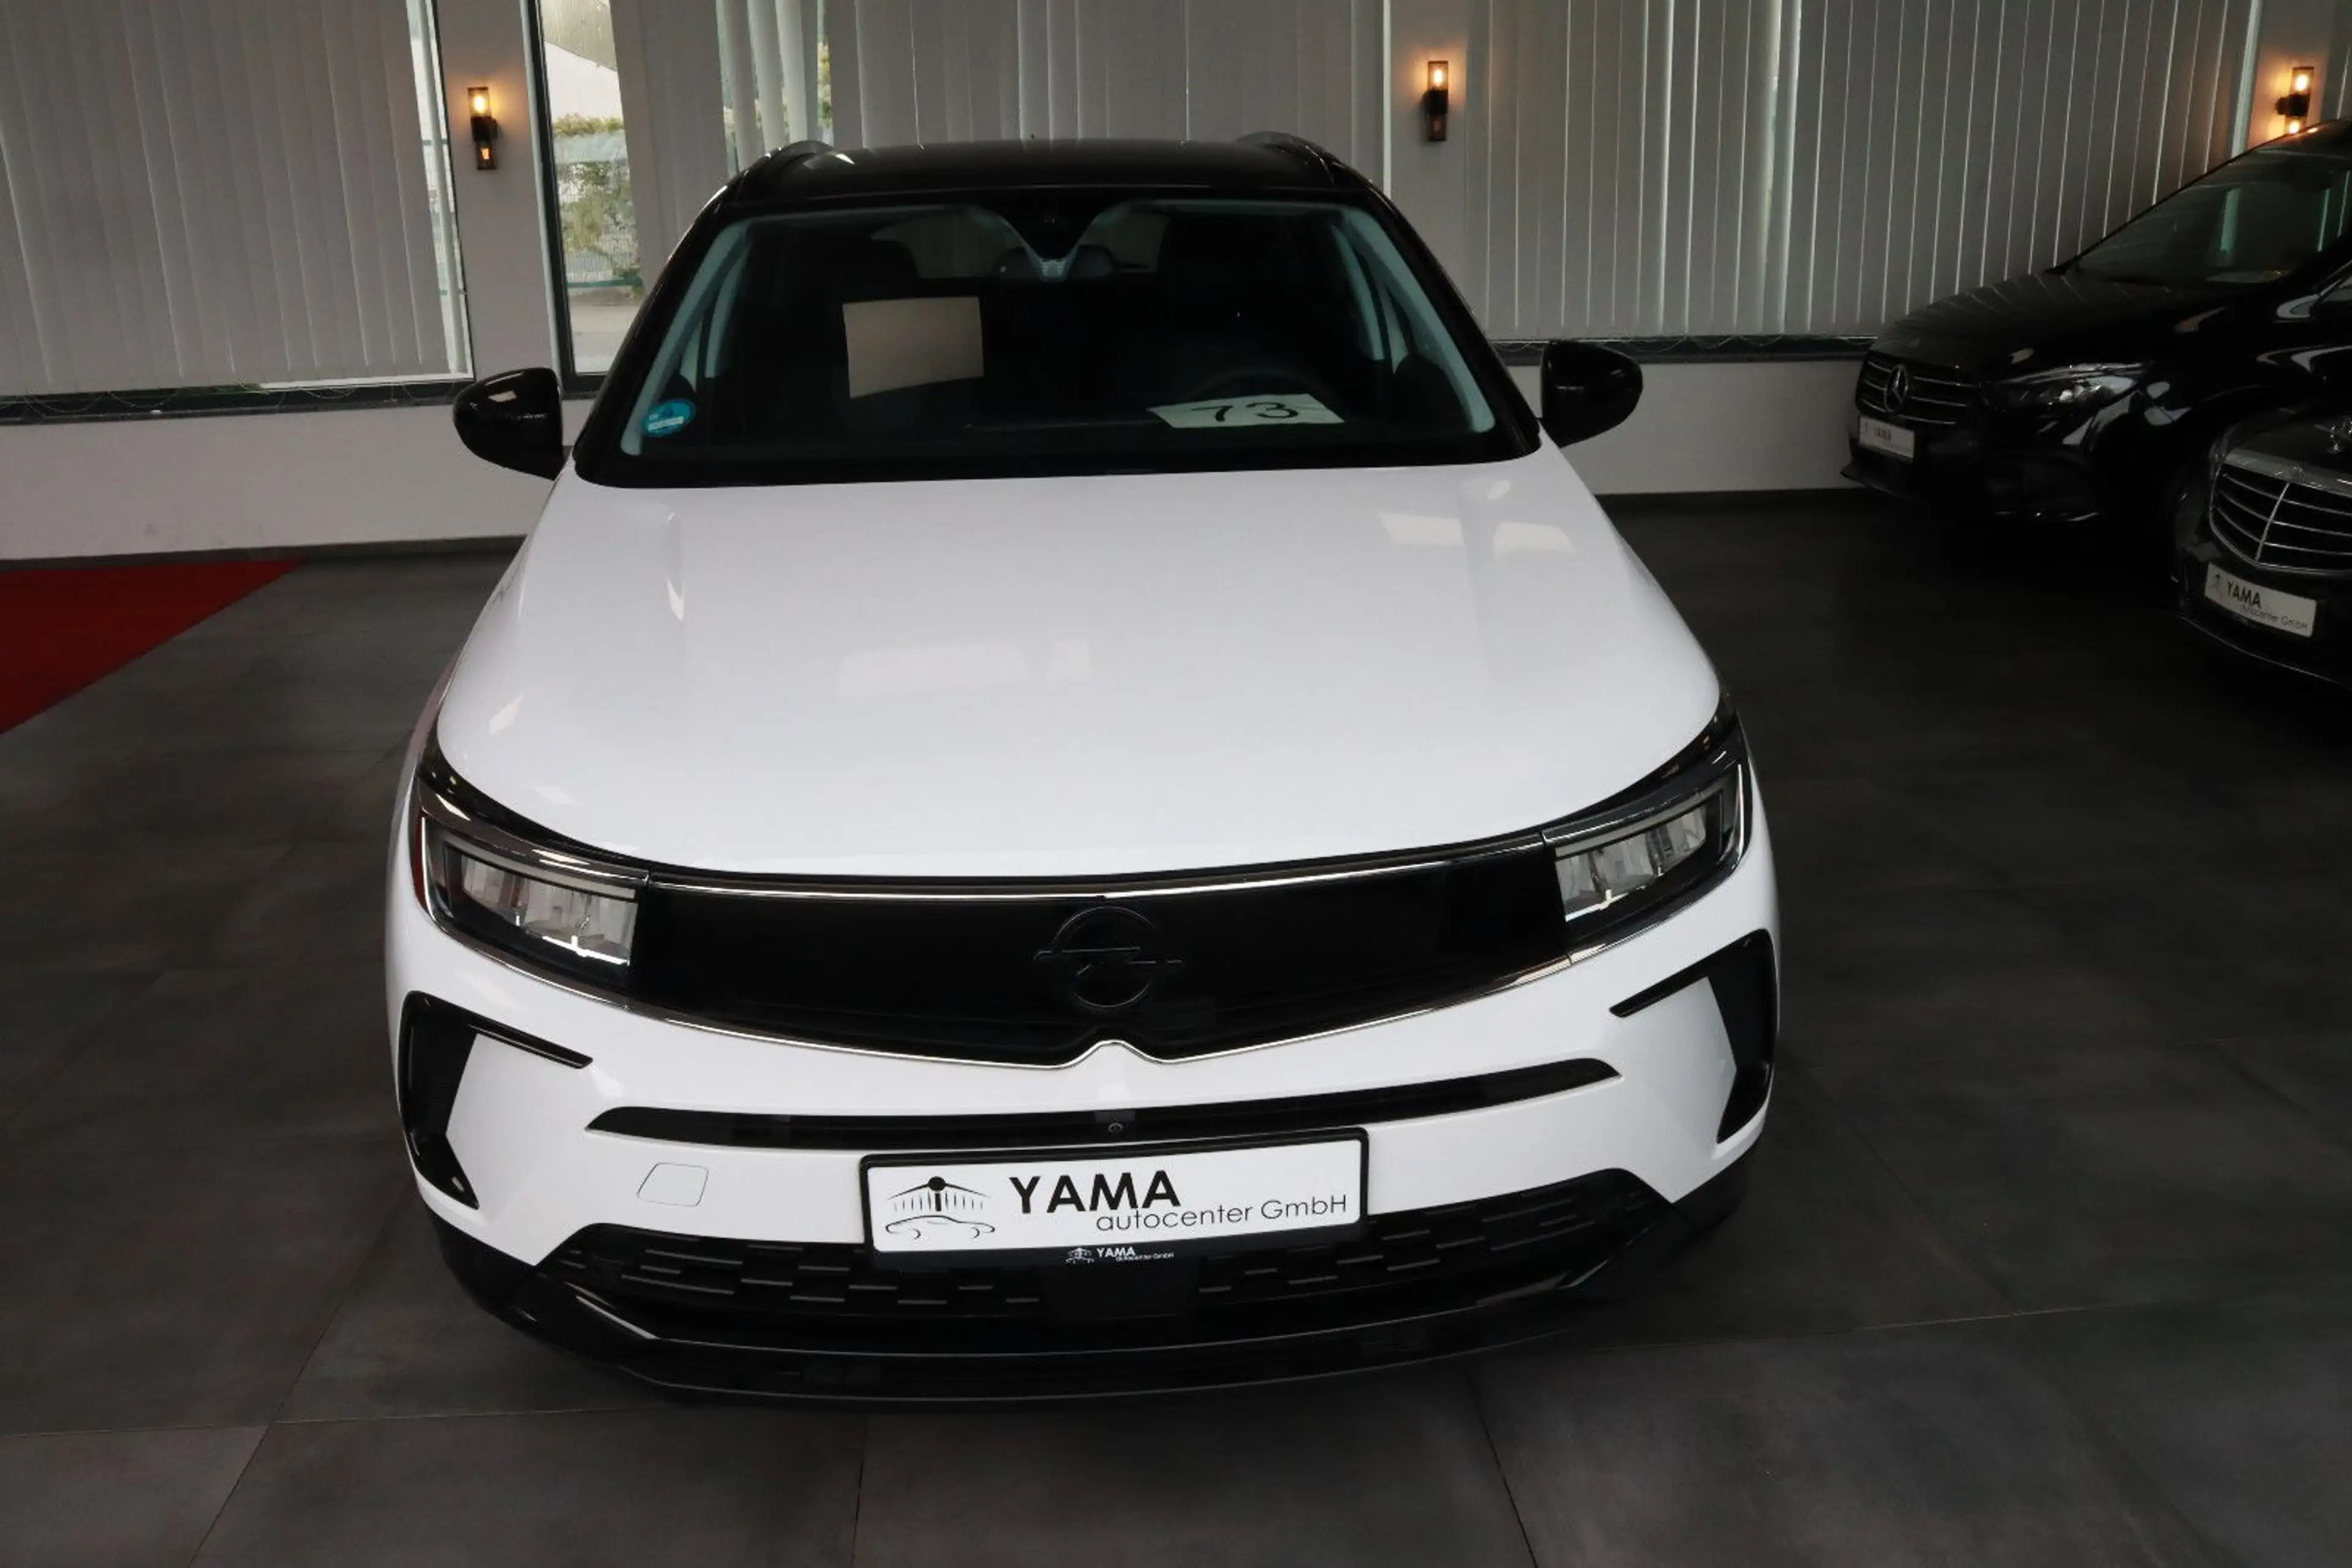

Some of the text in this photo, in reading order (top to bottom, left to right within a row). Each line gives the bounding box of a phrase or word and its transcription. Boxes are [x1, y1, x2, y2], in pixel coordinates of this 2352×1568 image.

[1191, 401, 1298, 422] 73
[2228, 581, 2261, 608] YAMA
[1009, 1170, 1181, 1214] YAMA
[1096, 1194, 1346, 1231] autocenter GmbH
[1097, 1246, 1136, 1257] YAMA
